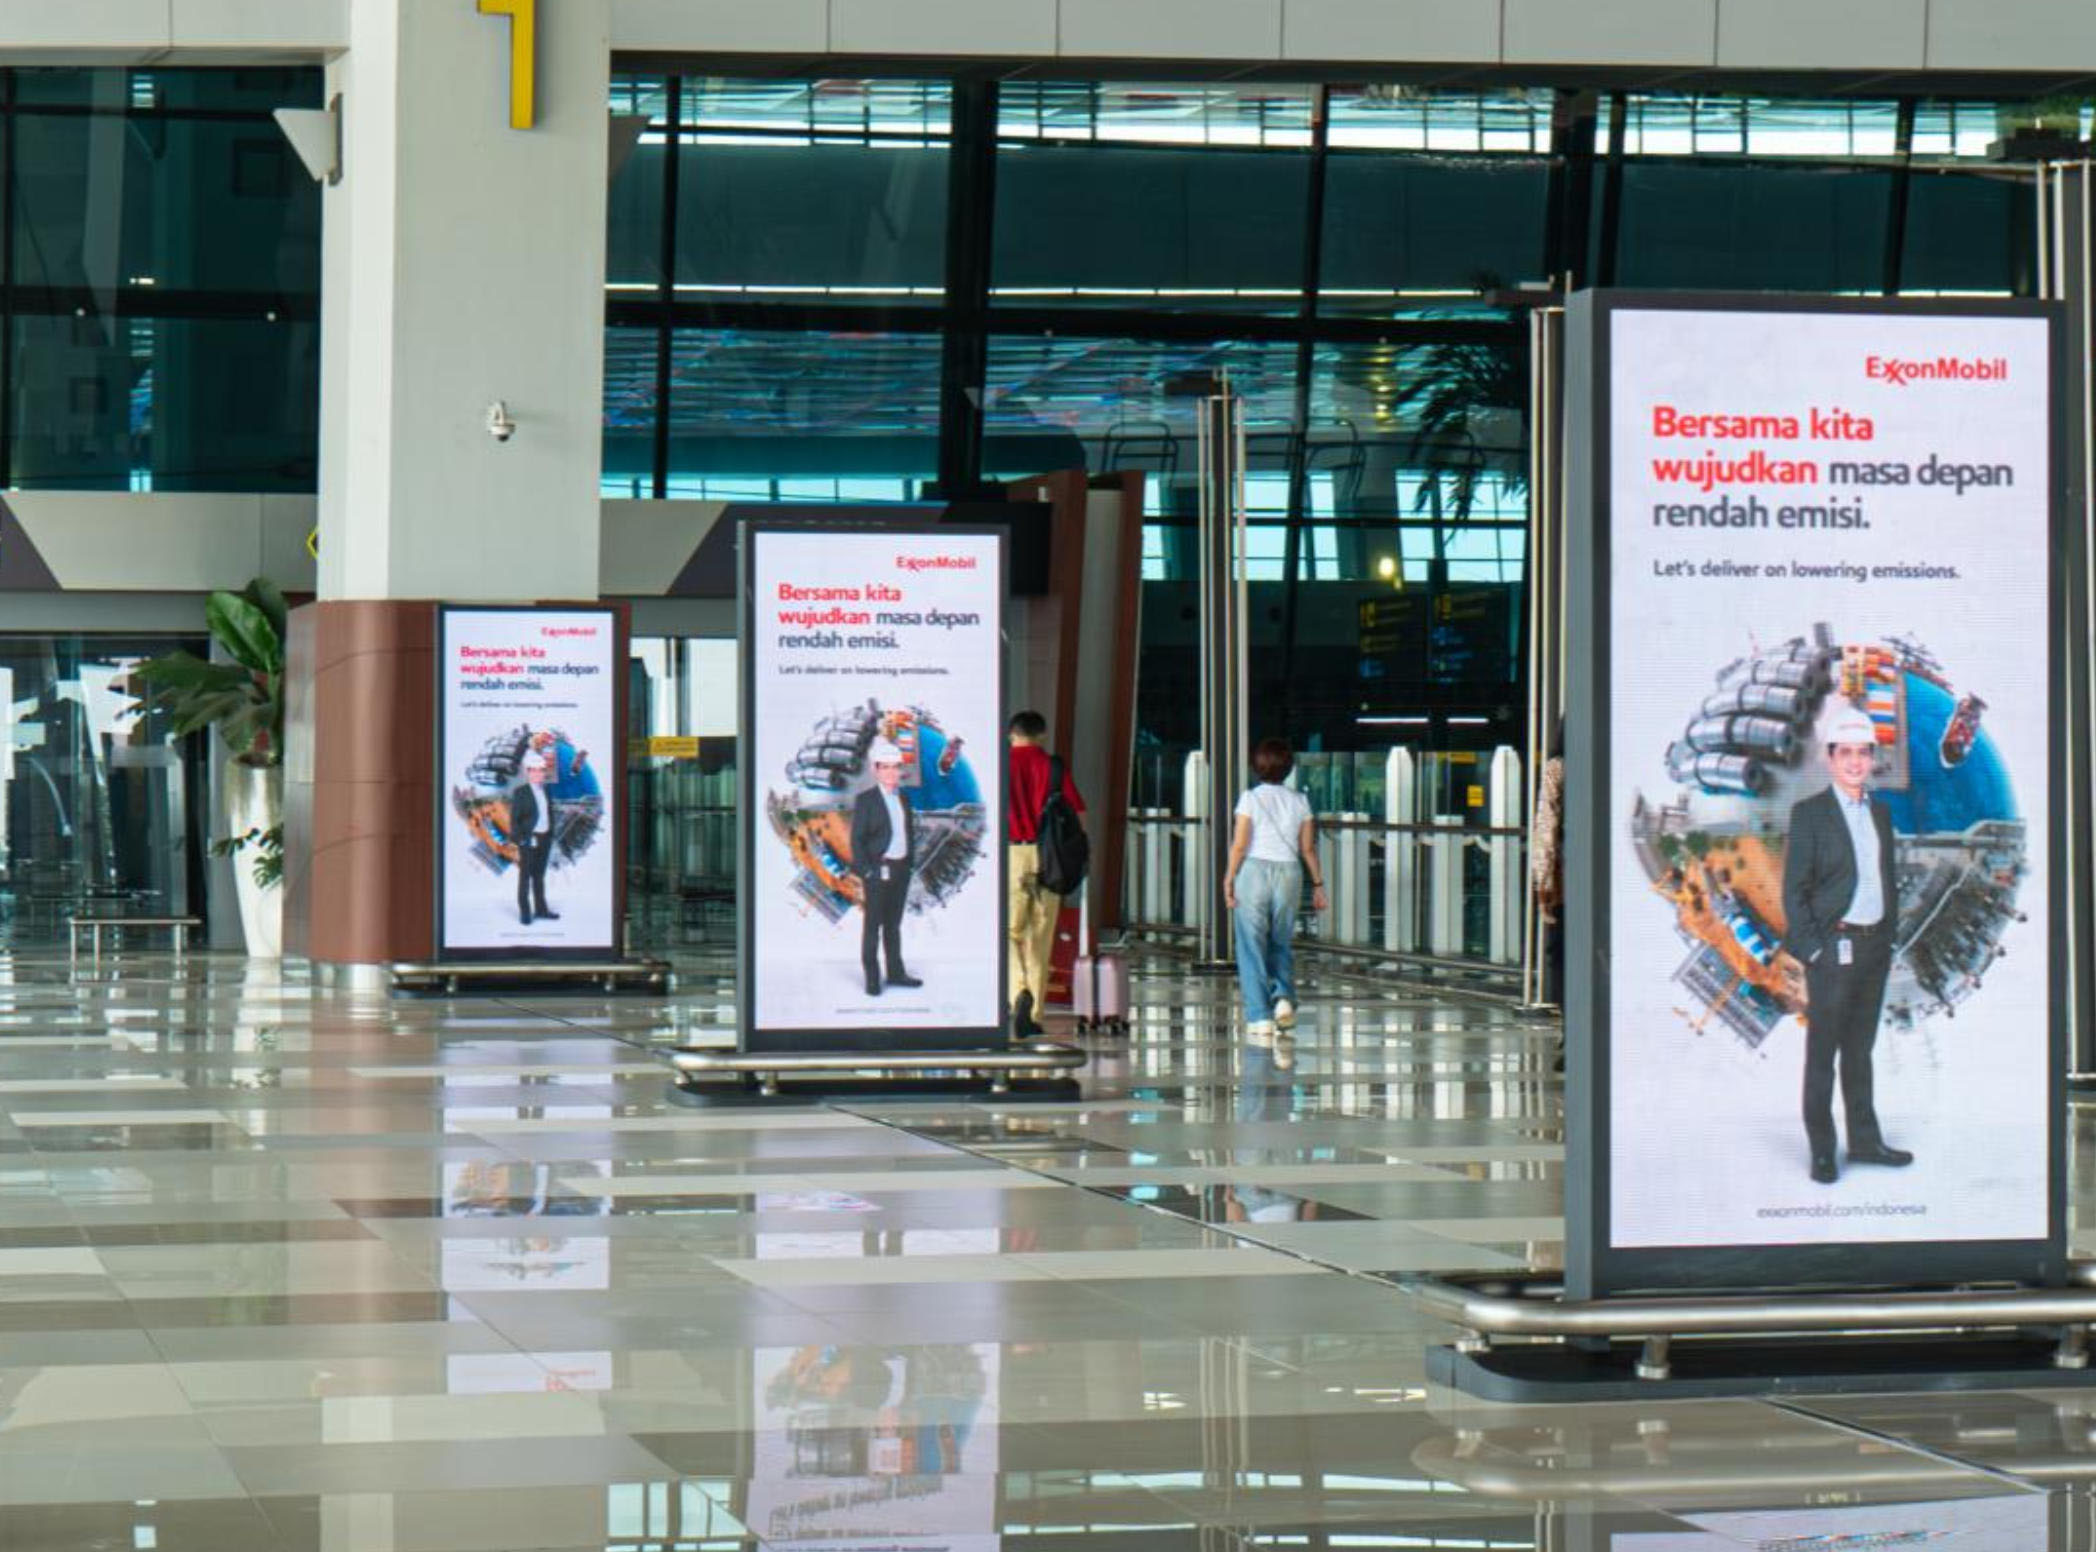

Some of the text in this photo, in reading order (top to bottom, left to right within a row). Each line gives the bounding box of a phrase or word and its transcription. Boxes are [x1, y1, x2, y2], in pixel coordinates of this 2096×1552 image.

[1867, 357, 2007, 385] ExxonMobil
[1653, 407, 1873, 440] Bersama kita
[1653, 451, 2013, 496] wujudkan masa depan
[1653, 496, 1869, 528] rendah emisi.
[896, 556, 976, 572] ExxonMobil
[1654, 561, 1961, 582] Let's deliver on lowering emissions.
[779, 583, 901, 601] Bersama kita
[779, 608, 979, 629] wujudkan masa depan
[779, 631, 899, 648] rendah emisi.
[461, 646, 546, 657] Bersama kita
[562, 663, 599, 677] depan
